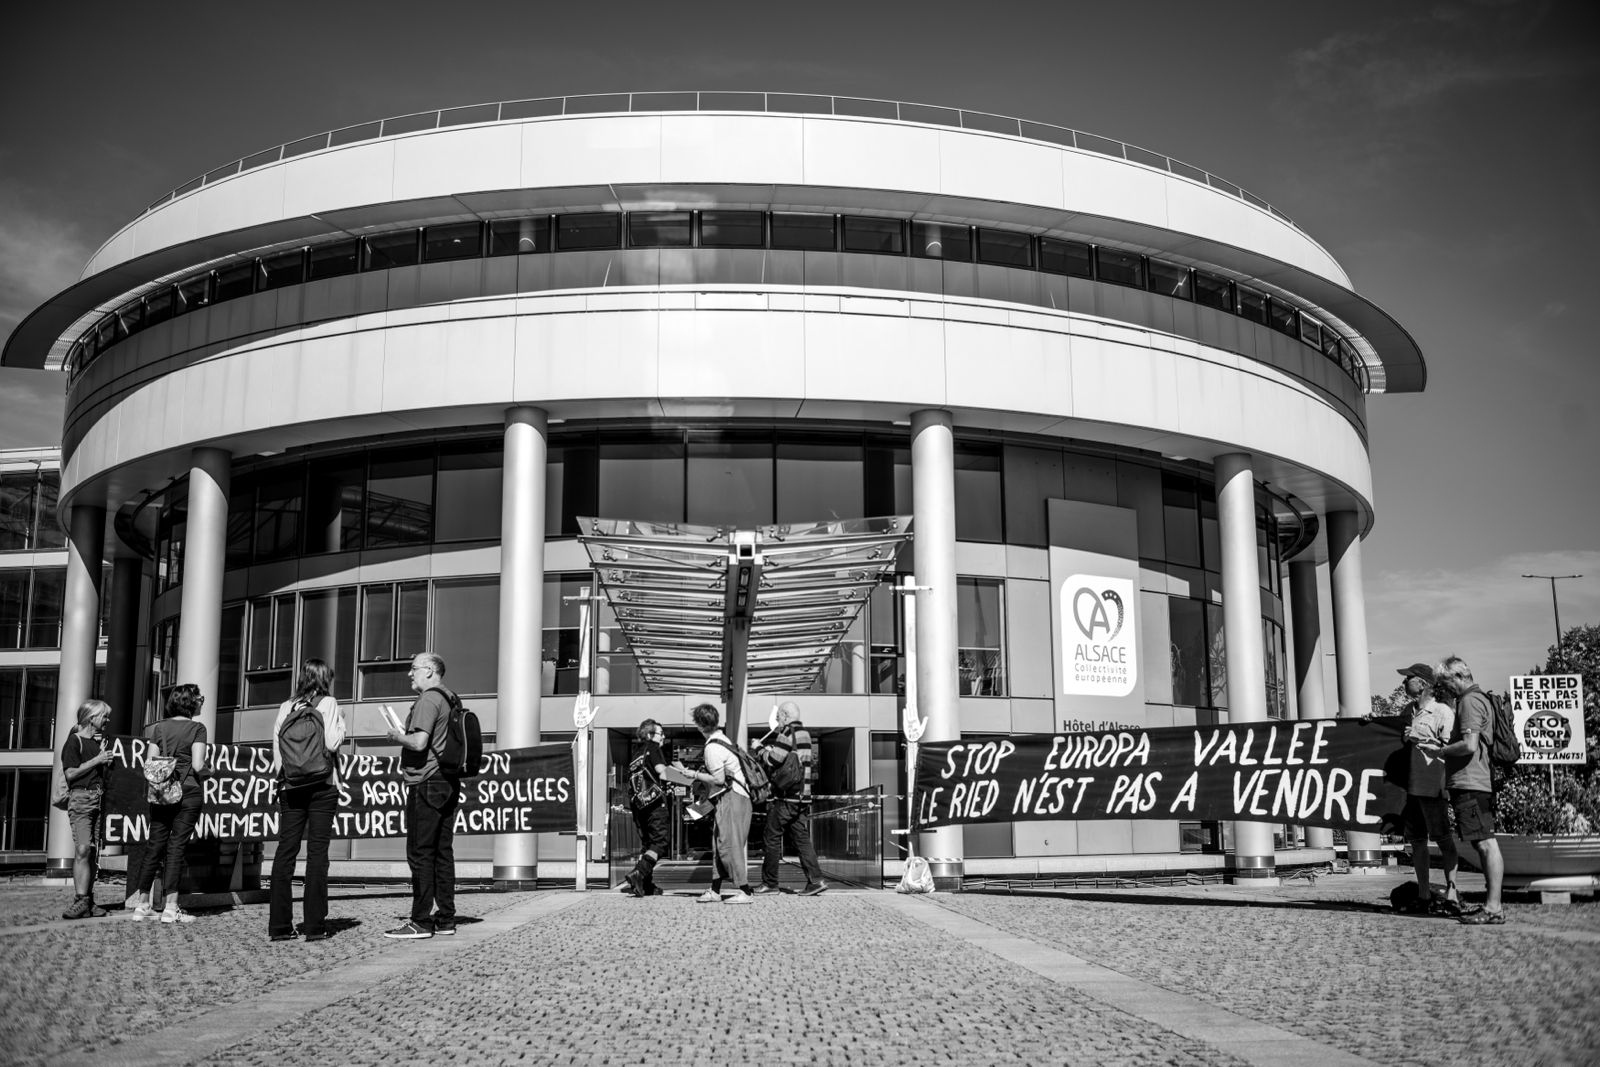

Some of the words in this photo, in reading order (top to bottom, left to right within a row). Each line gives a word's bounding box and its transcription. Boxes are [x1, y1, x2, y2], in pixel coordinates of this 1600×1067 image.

[1074, 643, 1126, 664] ALSACE
[1514, 678, 1533, 690] LE
[1540, 677, 1578, 689] RIED
[1514, 690, 1550, 700] N'EST
[1556, 690, 1578, 699] PAS
[1514, 701, 1522, 710] A
[1063, 718, 1095, 732] Hôtel
[1528, 717, 1570, 728] STOP
[1524, 730, 1571, 738] EUROPA
[941, 740, 1016, 779] STOP
[1044, 732, 1150, 770] EUROPA
[1194, 720, 1337, 767] VALLEE
[1525, 740, 1569, 748] VALLEE
[478, 777, 570, 804] SPOLIEES
[919, 787, 944, 824] LE
[949, 779, 1000, 818] RIED
[1012, 772, 1095, 815] N'EST
[1106, 771, 1163, 814] PAS
[1170, 770, 1198, 813] A
[1233, 767, 1387, 824] VENDRE
[453, 806, 532, 833] ACRIFIE
